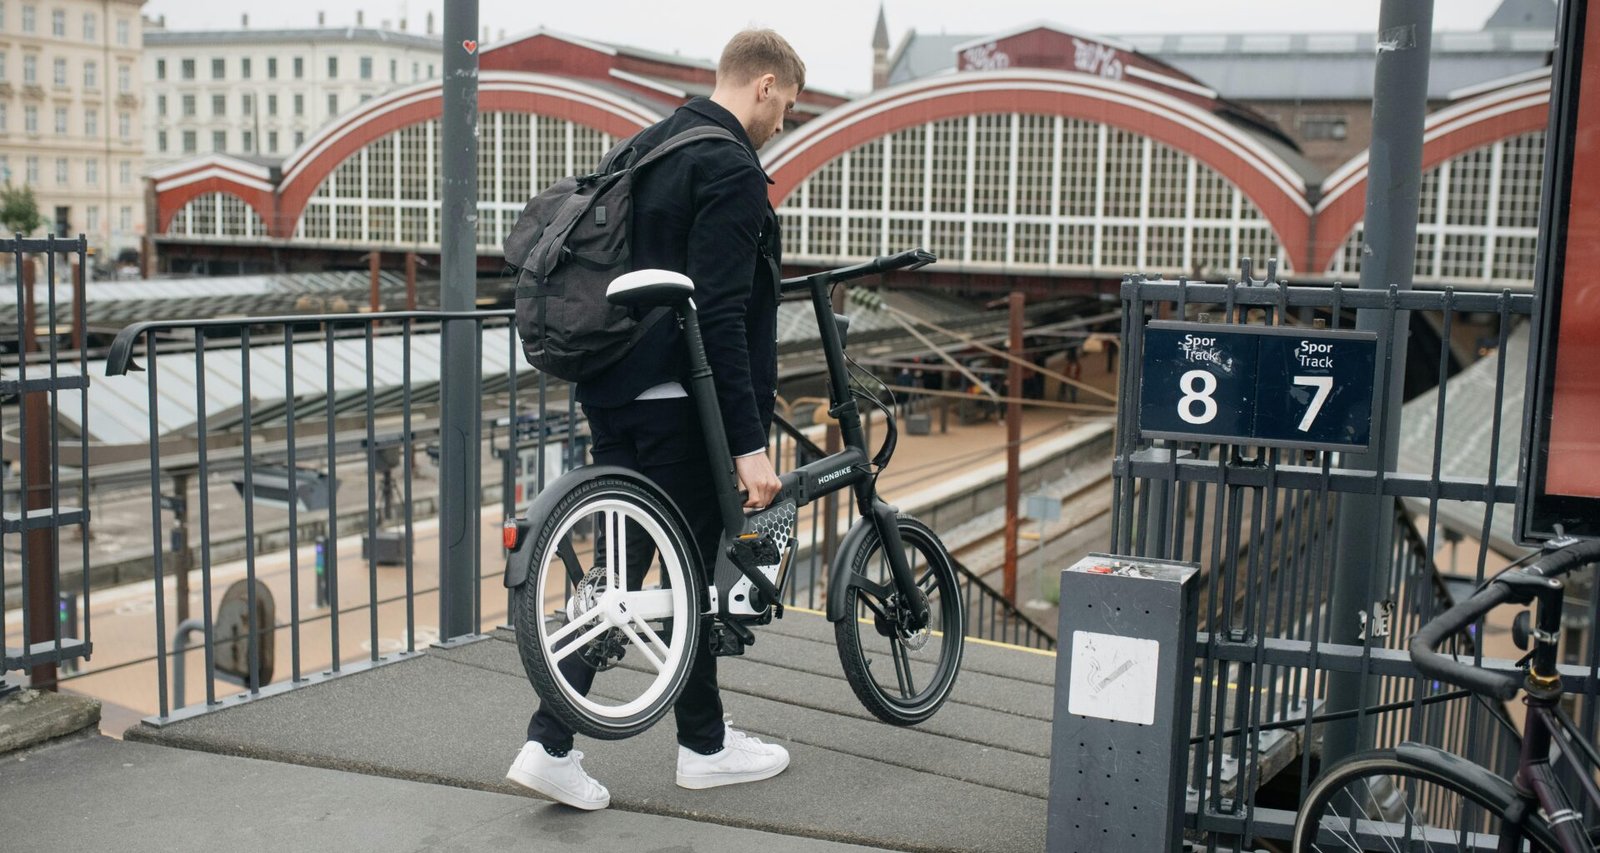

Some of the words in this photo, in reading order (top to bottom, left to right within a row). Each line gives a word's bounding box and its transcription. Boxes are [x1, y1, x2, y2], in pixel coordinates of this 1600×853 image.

[1184, 334, 1216, 347] Spor
[1300, 340, 1333, 354] Spor
[1185, 349, 1217, 361] Track
[1299, 355, 1333, 368] Track
[1177, 369, 1218, 425] 8
[1293, 376, 1334, 432] 7
[817, 465, 852, 485] HONBIKE
